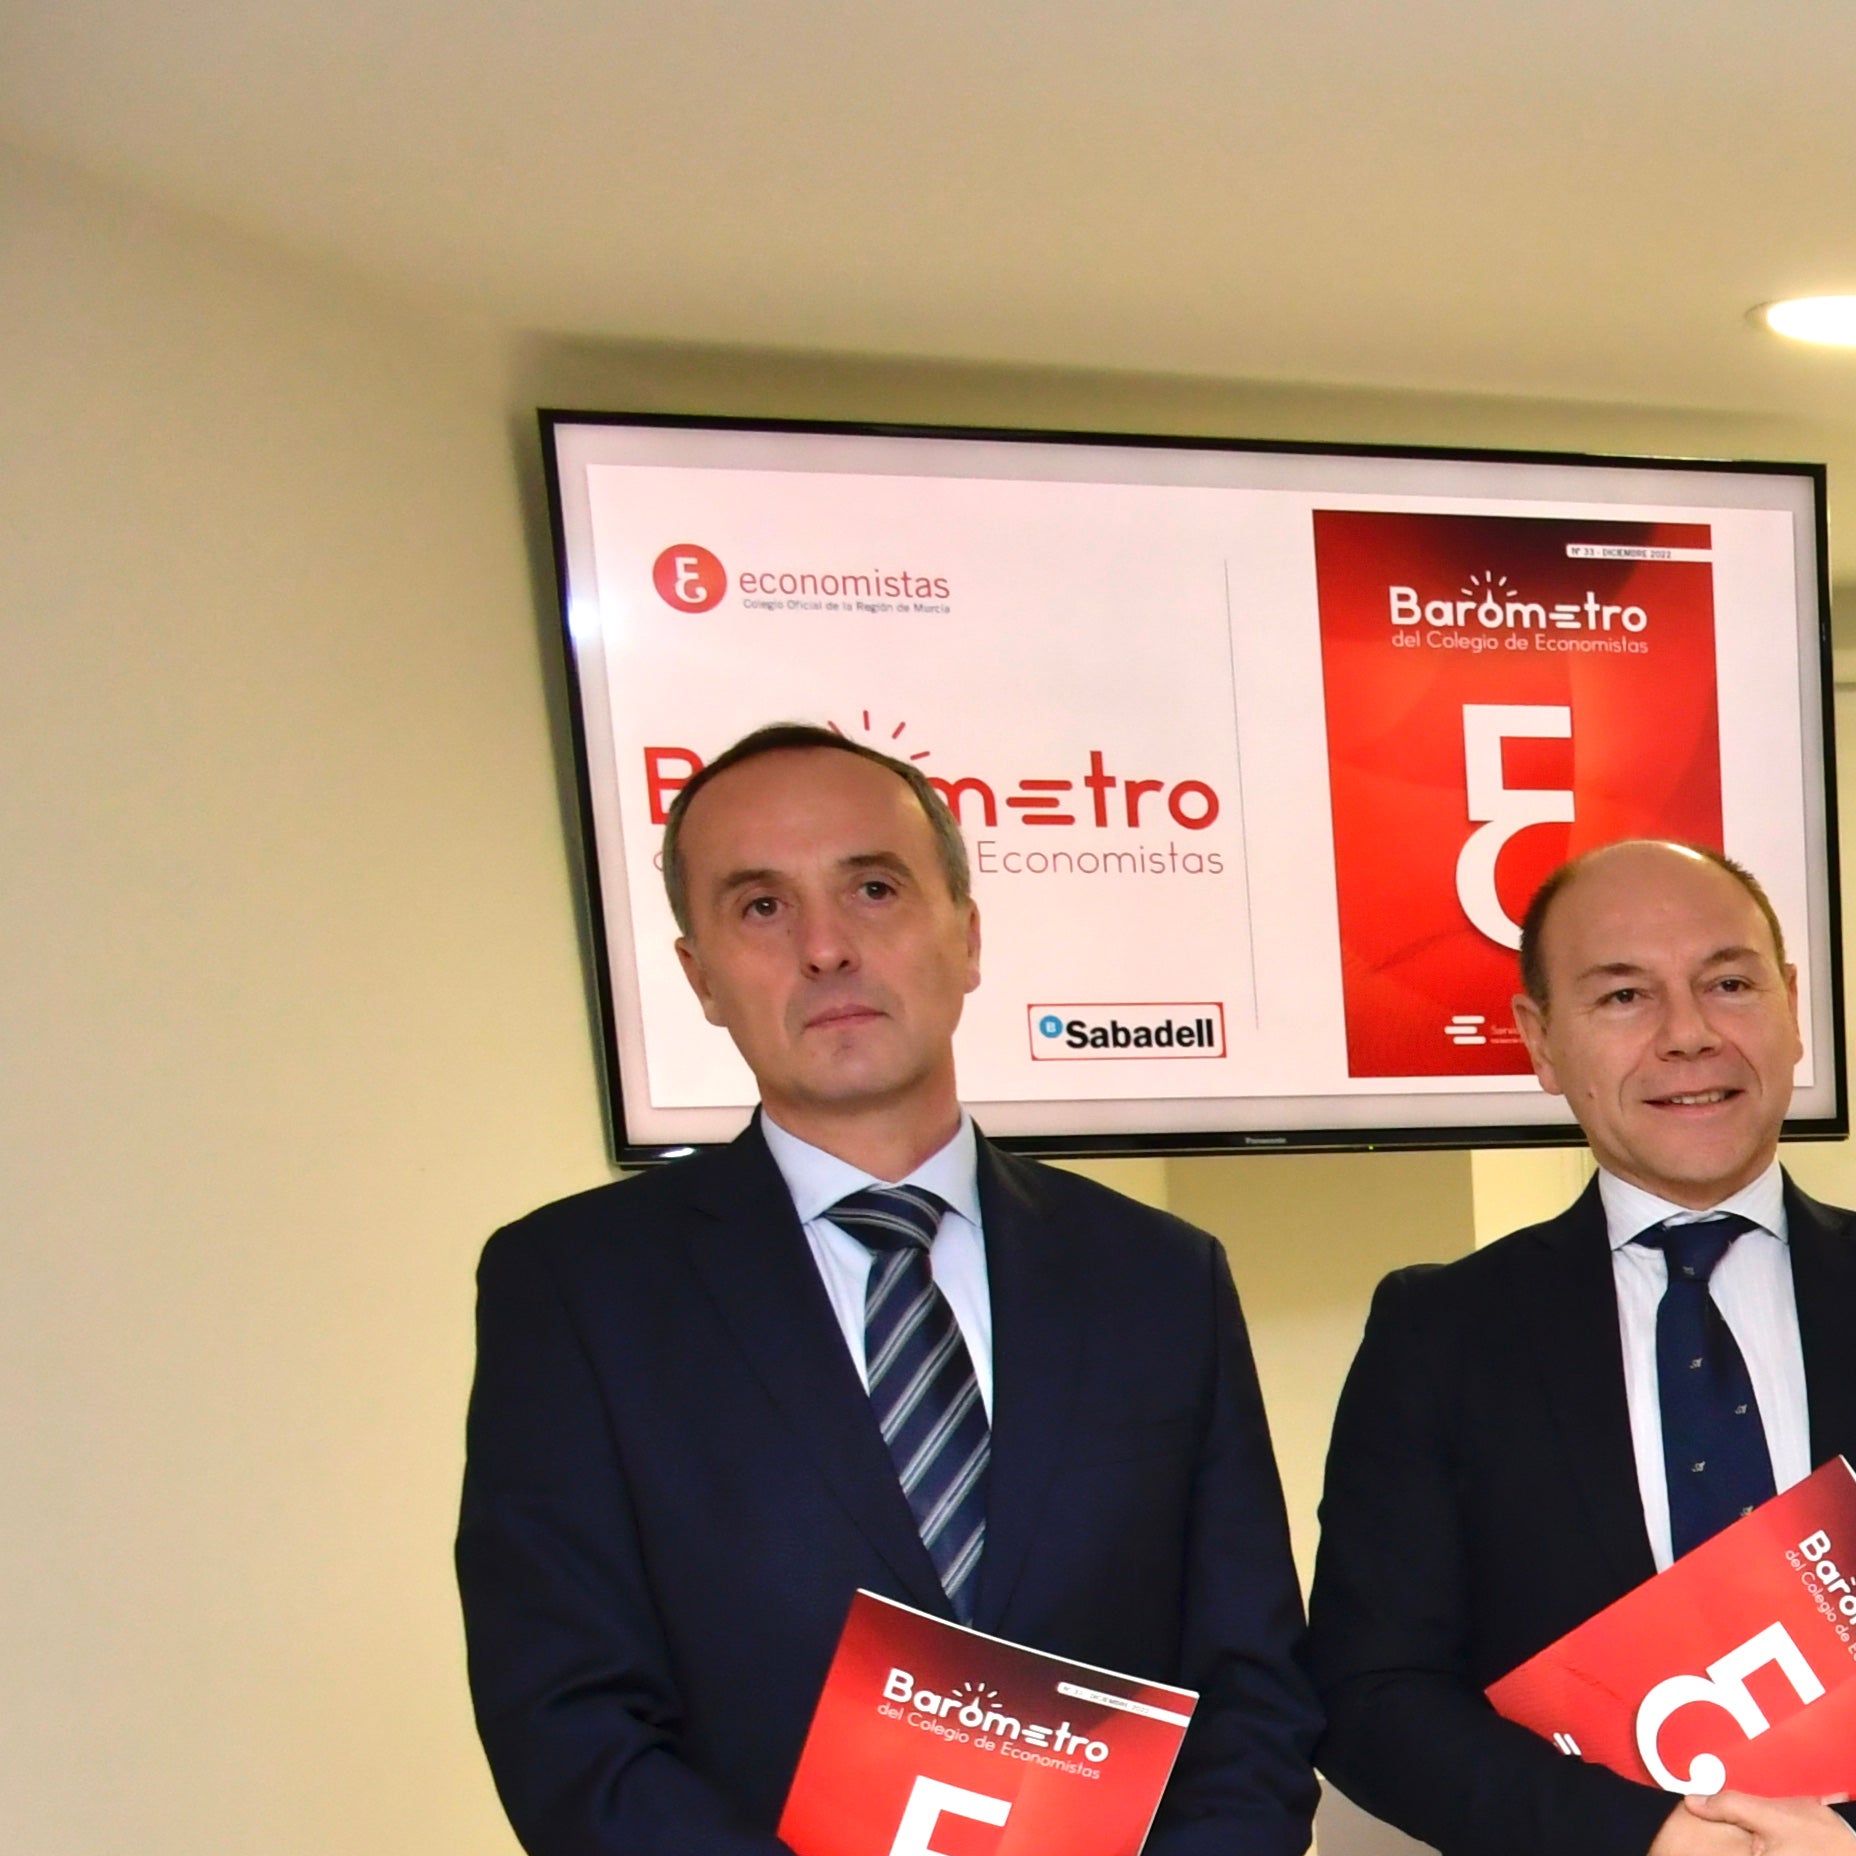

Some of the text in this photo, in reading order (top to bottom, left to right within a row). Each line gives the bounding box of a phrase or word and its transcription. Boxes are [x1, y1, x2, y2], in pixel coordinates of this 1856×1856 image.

[739, 568, 950, 599] economistas
[743, 599, 784, 612] Colegio
[825, 601, 840, 611] de
[842, 601, 853, 612] la
[896, 603, 910, 613] de
[913, 603, 950, 614] Murcia
[1392, 629, 1649, 654] del Colegio de Economistas
[976, 840, 1225, 875] Economistas
[1066, 1018, 1214, 1049] Sabadell
[1785, 1548, 1806, 1573] del
[1801, 1571, 1837, 1624] Colegio
[1835, 1622, 1850, 1642] de
[877, 1702, 1101, 1780] del Colegio de Economistas
